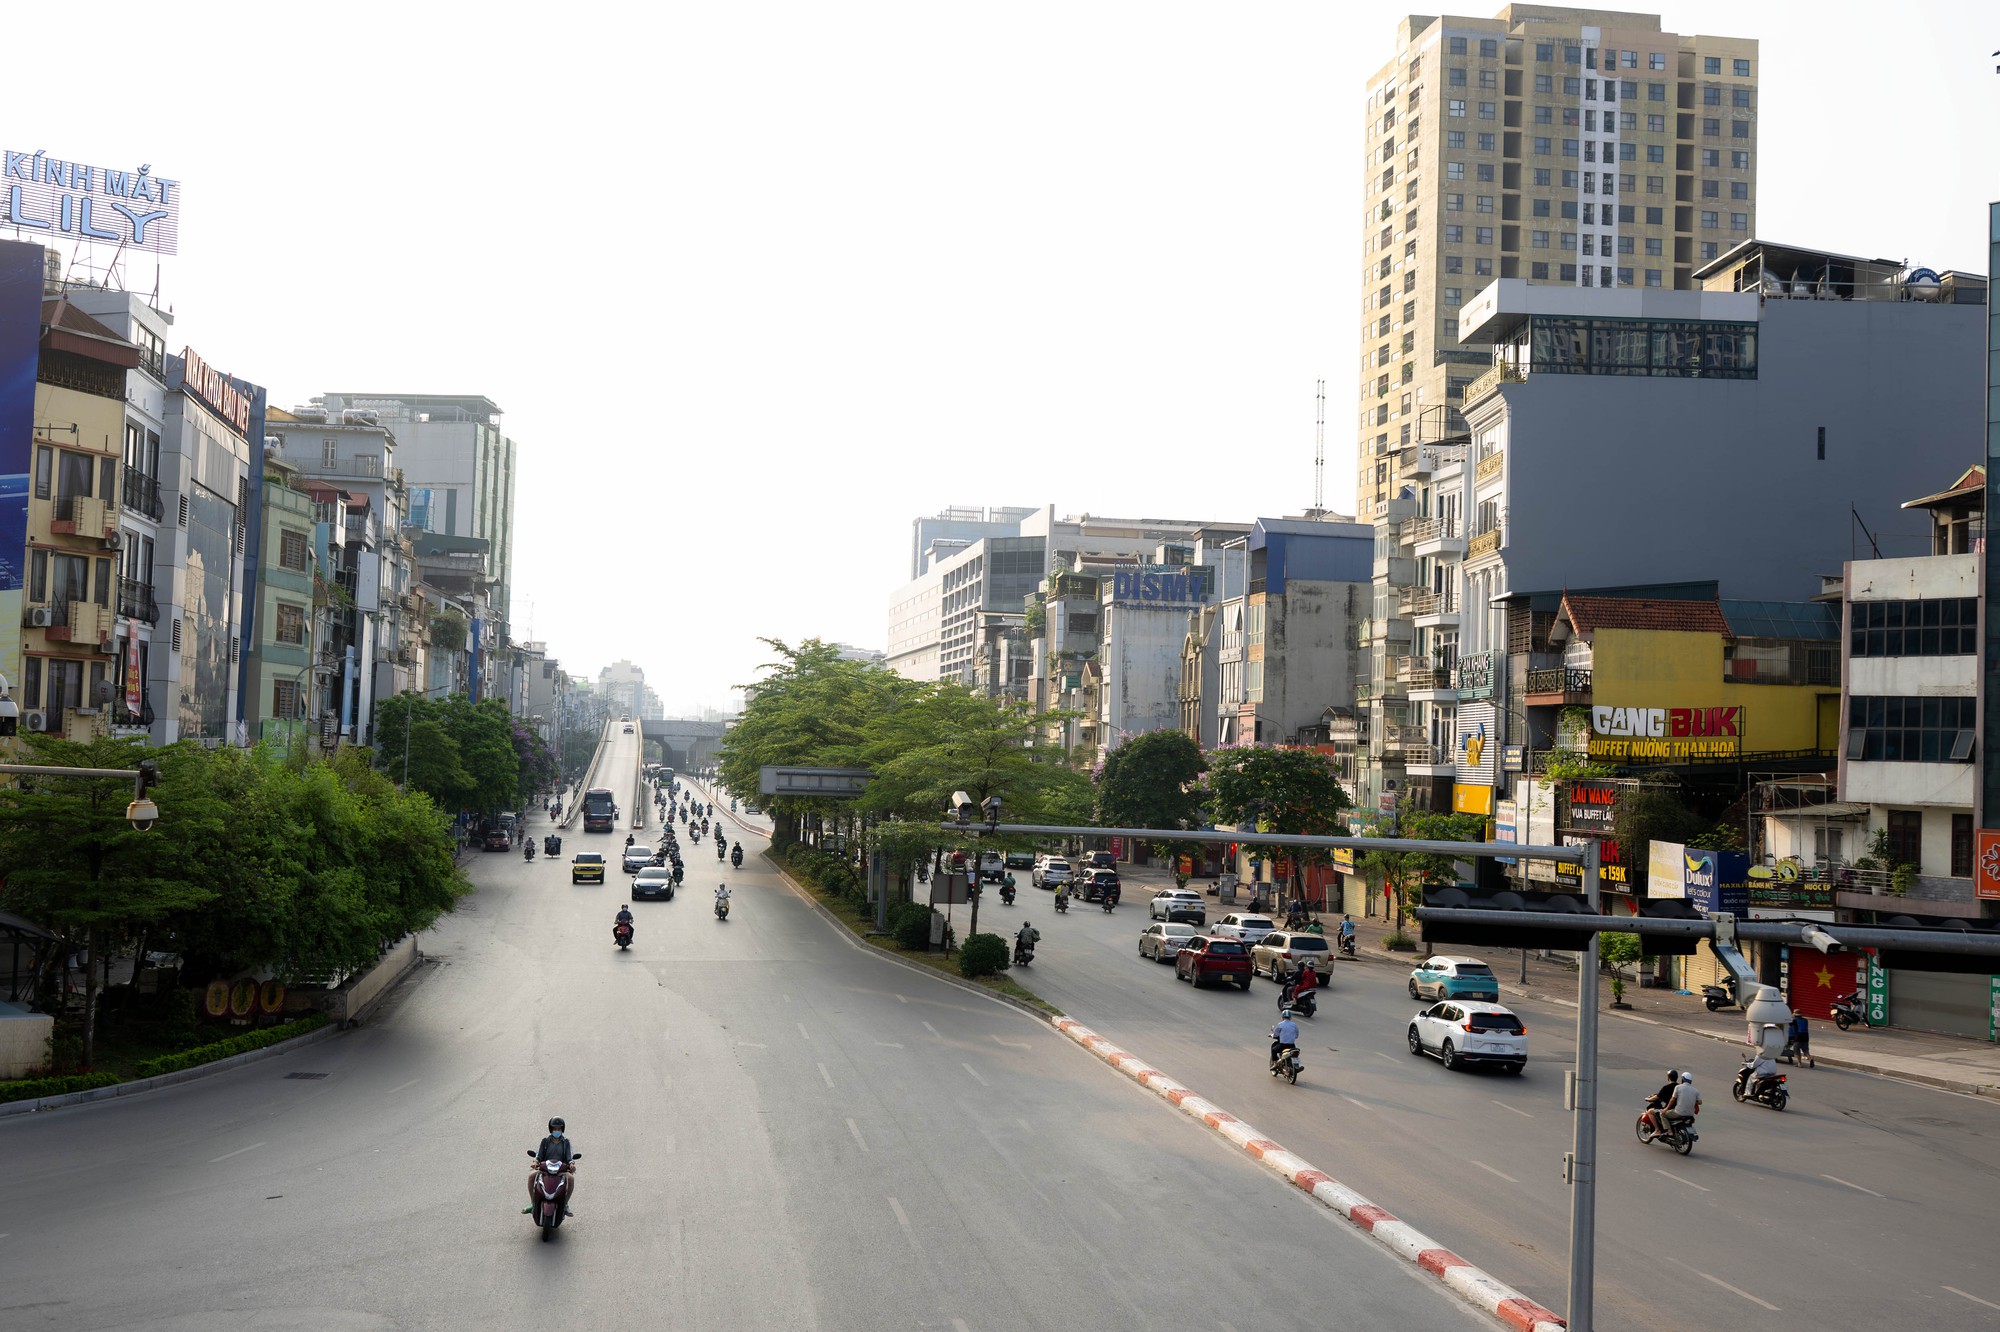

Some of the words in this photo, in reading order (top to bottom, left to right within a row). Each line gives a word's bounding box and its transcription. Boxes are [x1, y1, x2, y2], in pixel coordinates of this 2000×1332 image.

[5, 149, 93, 191] KÍNH
[105, 164, 176, 205] MẮT
[10, 185, 169, 244] LILY
[1592, 705, 1665, 737] GANG
[1670, 706, 1739, 737] BUK
[1589, 740, 1630, 756] BUFFET
[1674, 741, 1707, 758] THAN
[1588, 787, 1615, 805] WANG
[1572, 808, 1583, 819] VUA
[1584, 809, 1602, 820] BUFFET
[1600, 839, 1620, 862] UK
[1558, 862, 1575, 875] BUFFET
[1608, 865, 1626, 882] 159K
[1686, 868, 1711, 887] Dulux
[1697, 889, 1712, 898] colour
[1872, 994, 1884, 1020] HỒ
